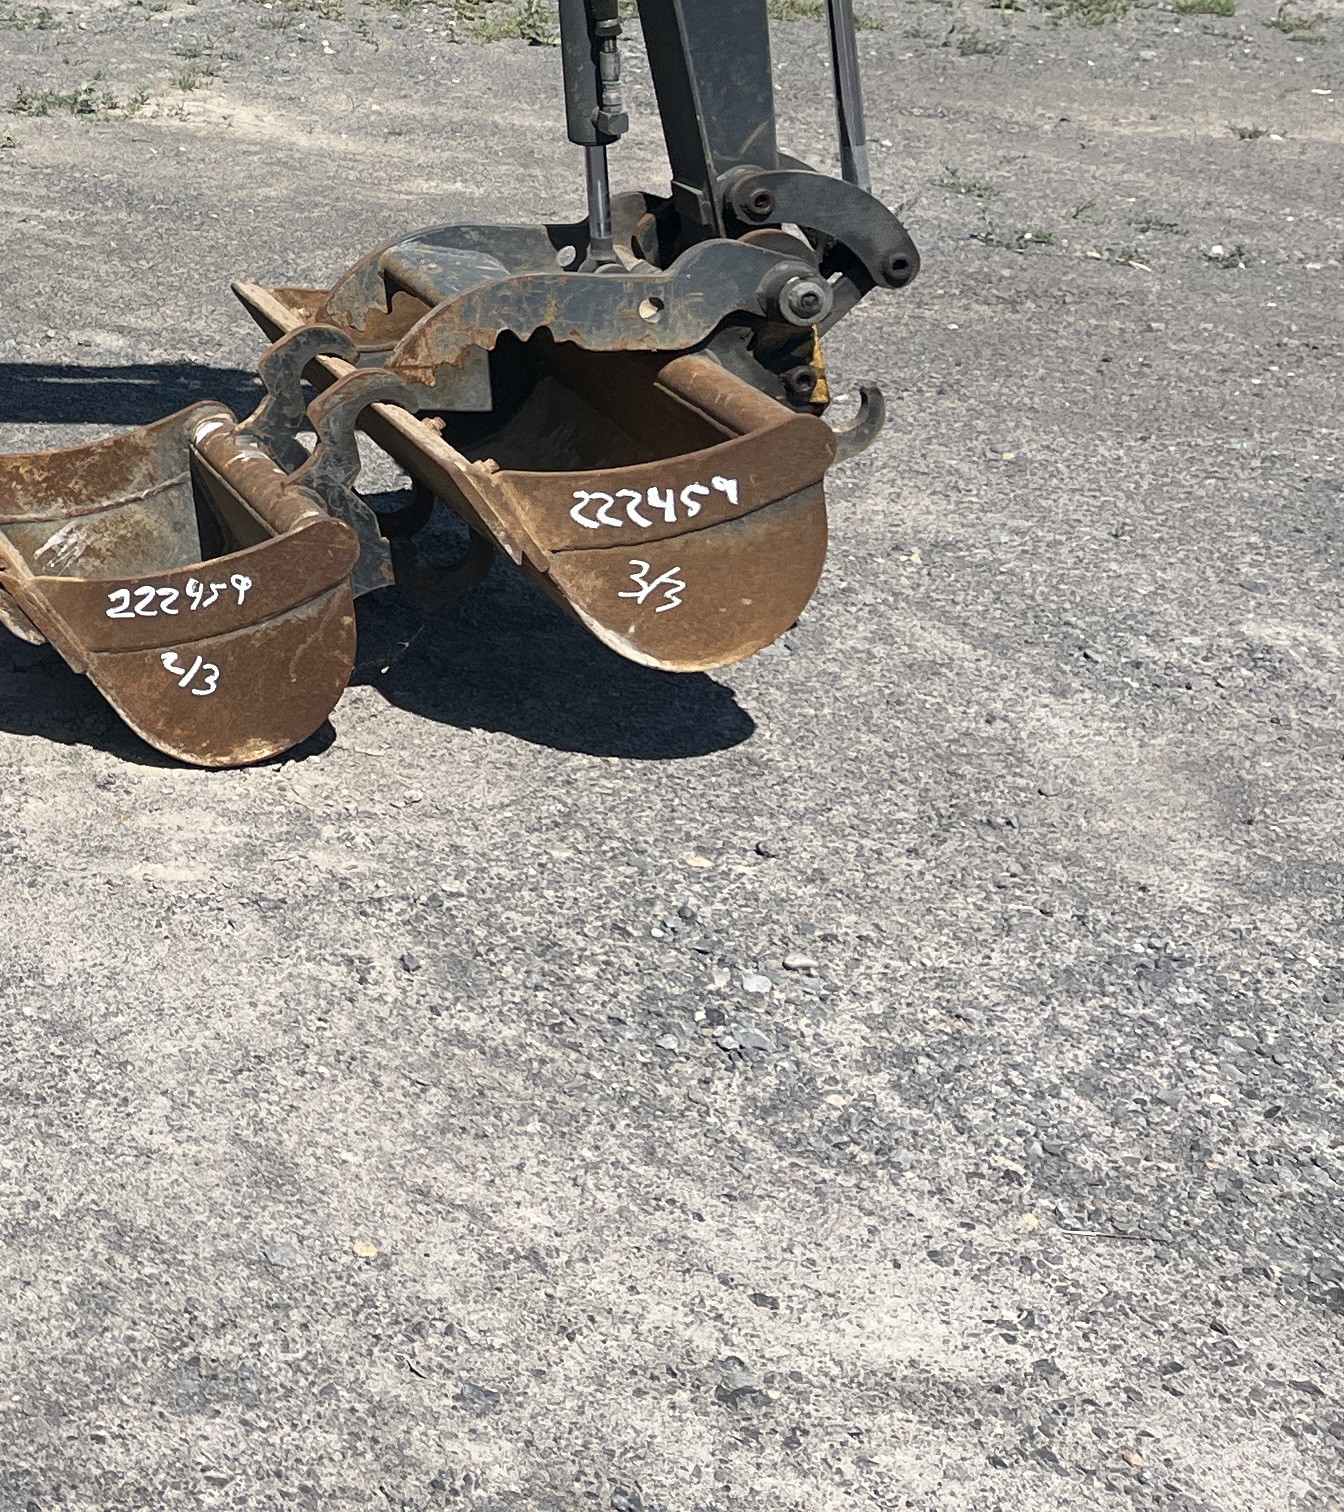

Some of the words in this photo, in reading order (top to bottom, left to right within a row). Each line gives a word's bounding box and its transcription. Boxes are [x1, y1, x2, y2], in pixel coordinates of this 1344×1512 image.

[569, 475, 739, 529] 222459
[617, 559, 686, 613] 3/3
[160, 651, 220, 696] 2/3
